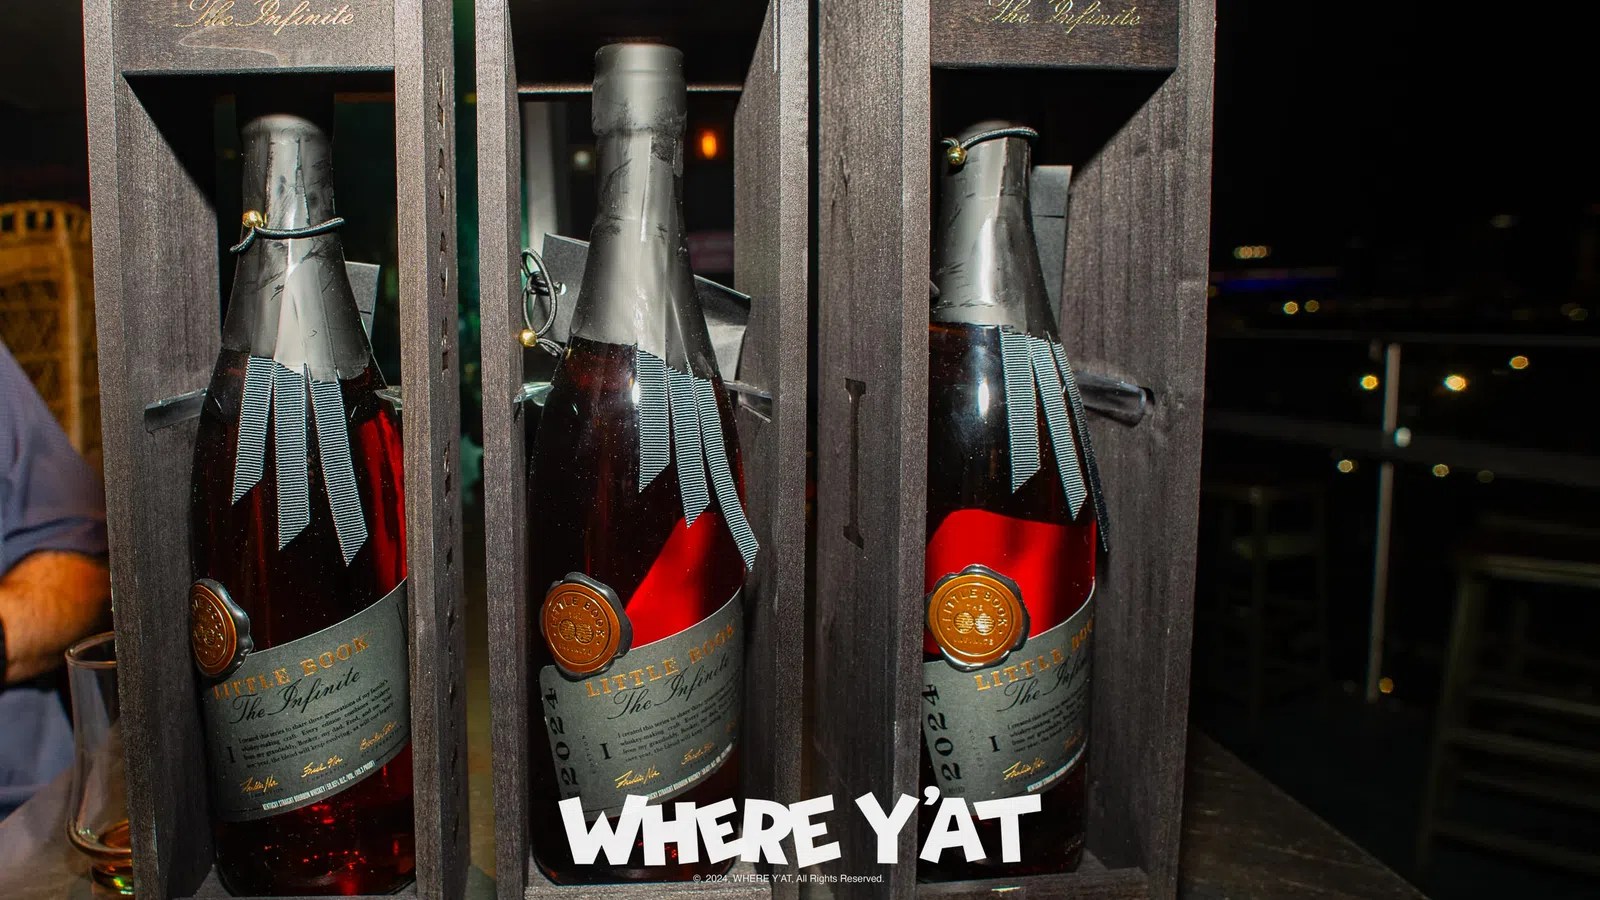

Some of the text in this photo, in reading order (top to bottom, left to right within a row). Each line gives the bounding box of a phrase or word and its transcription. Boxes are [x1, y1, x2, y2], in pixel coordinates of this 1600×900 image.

[173, 0, 355, 36] The Infinite
[974, 0, 1142, 34] The Infinite
[582, 601, 605, 638] BOOK
[942, 588, 1008, 627] LITTLE BOOK
[212, 630, 373, 700] LITTLE BOOK
[585, 620, 735, 697] LITTLE BOOK
[974, 647, 1064, 691] LITTLE
[229, 667, 360, 724] The Infinite
[325, 700, 356, 719] generations
[607, 685, 651, 720] The
[997, 675, 1041, 713] The
[301, 727, 318, 737] Every
[321, 716, 342, 728] edition
[344, 702, 369, 717] combines
[545, 687, 579, 786] 2024
[622, 727, 643, 738] created
[921, 683, 962, 782] 2024
